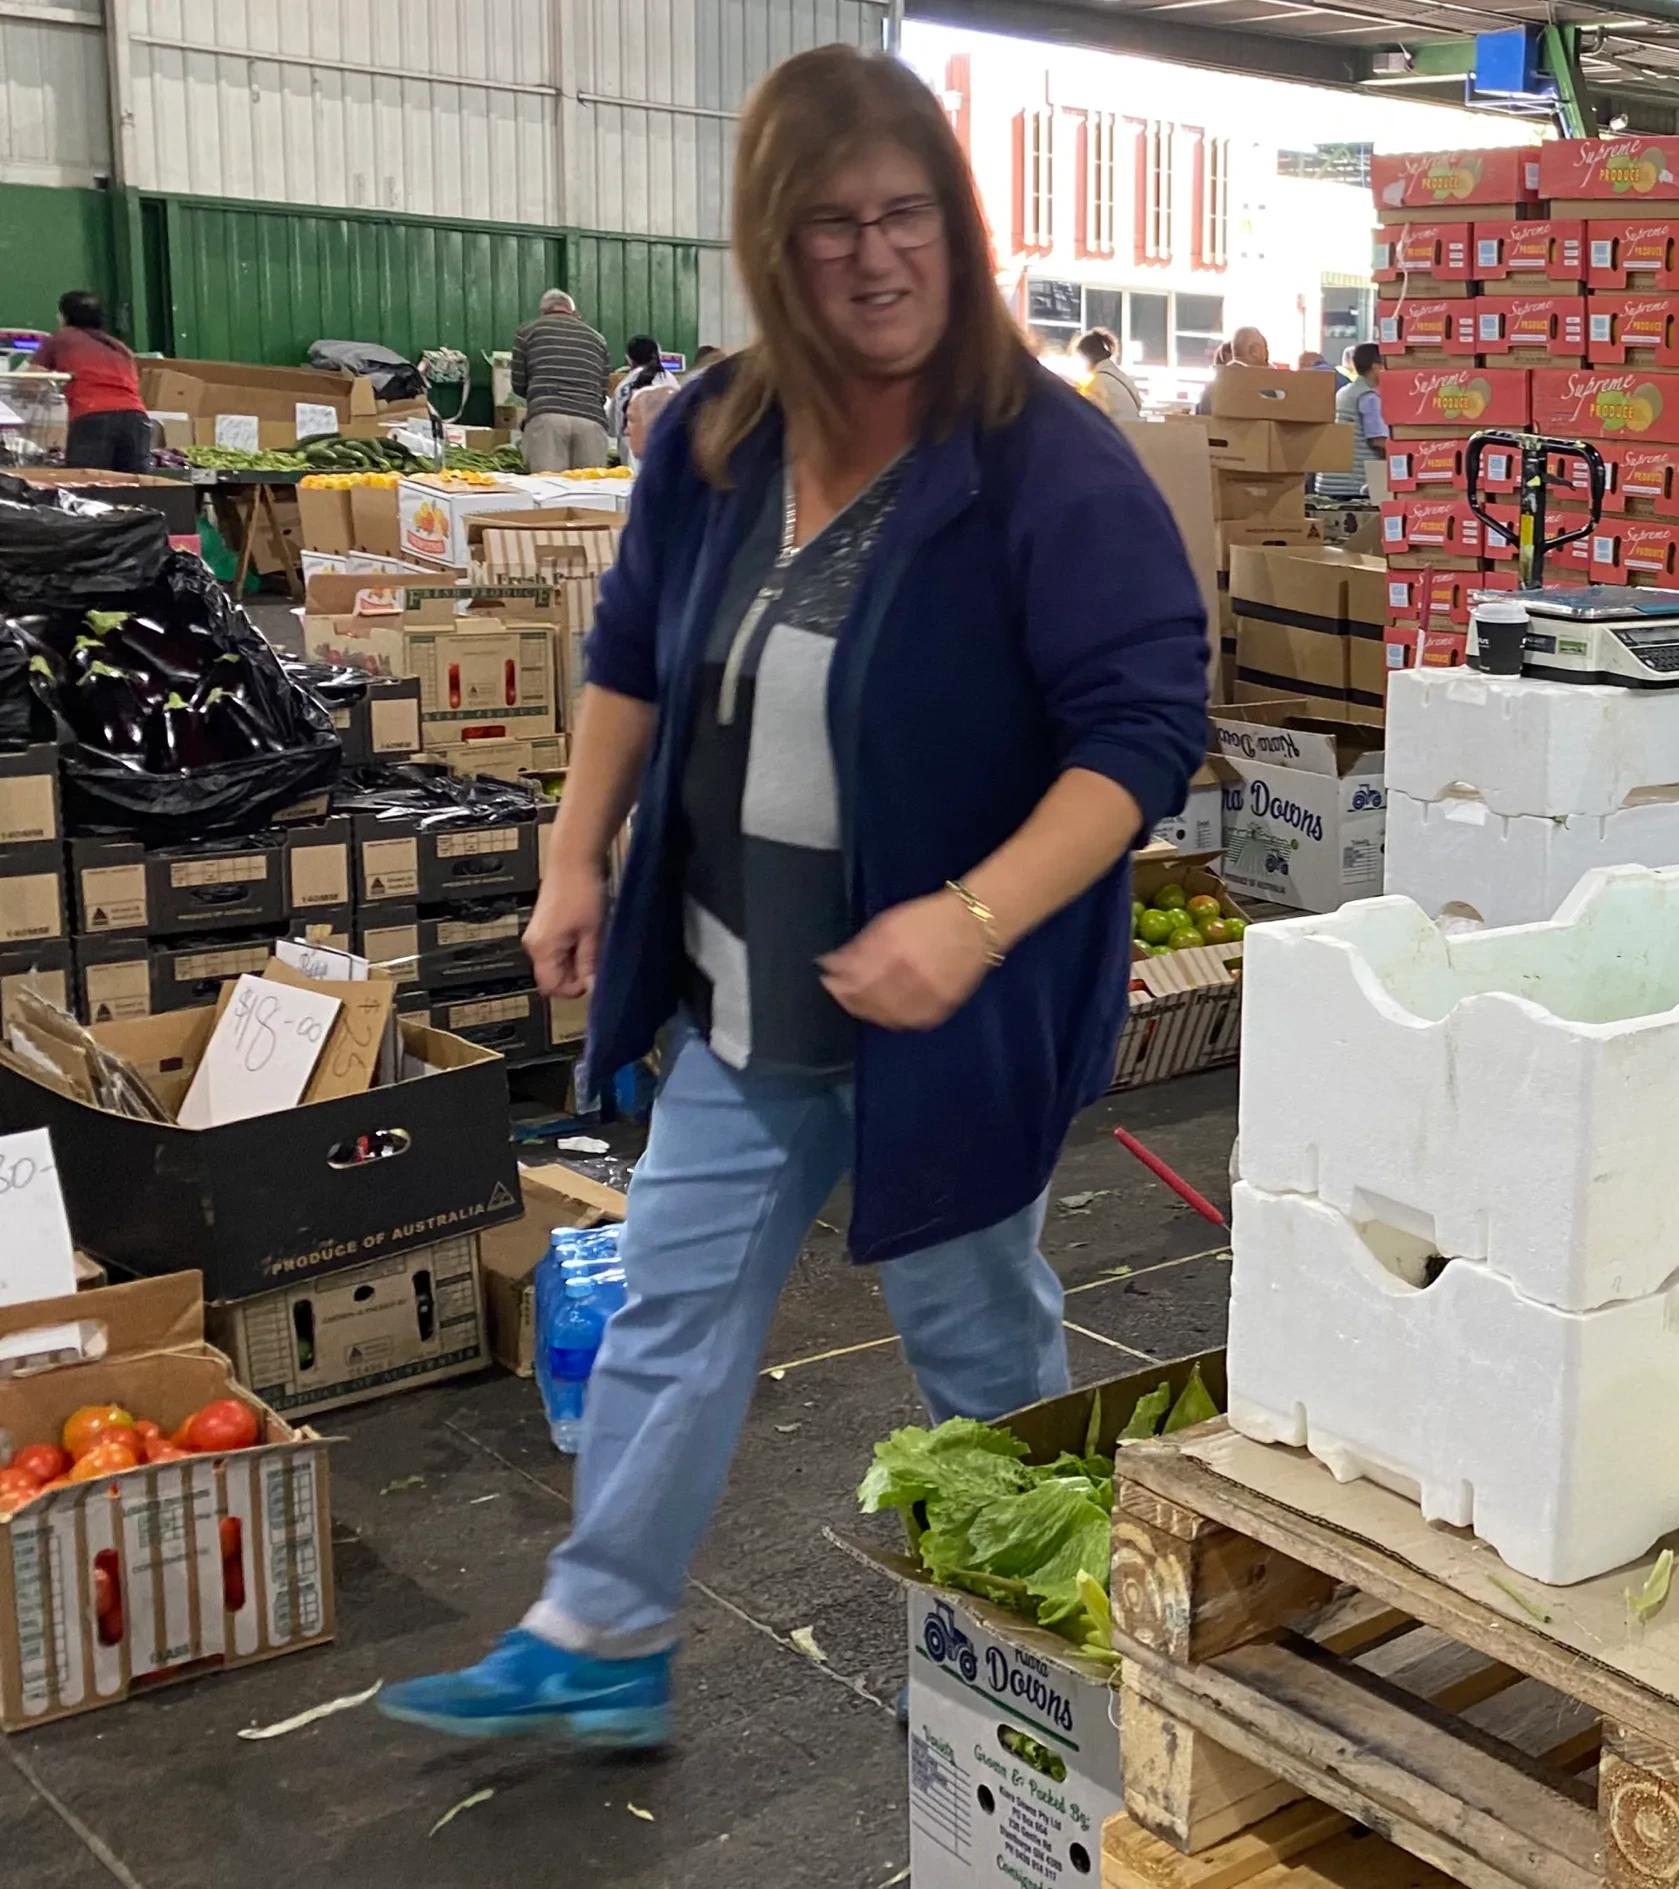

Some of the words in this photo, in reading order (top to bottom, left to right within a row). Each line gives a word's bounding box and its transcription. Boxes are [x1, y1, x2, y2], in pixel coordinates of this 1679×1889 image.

[1573, 140, 1642, 188] Supreme
[1600, 168, 1640, 182] PRODUCE
[1507, 224, 1551, 255] Supreme
[1621, 224, 1669, 257] Supreme
[1406, 302, 1447, 331] Supreme
[1508, 300, 1552, 330] Supreme
[1619, 300, 1669, 331] Supreme
[1410, 370, 1469, 415] Supreme
[1432, 394, 1468, 409] PRODUCE
[1561, 373, 1635, 421] Supreme
[1589, 404, 1633, 419] PRODUCE
[1621, 452, 1670, 480] Supreme
[1622, 527, 1671, 554] Supreme
[1216, 728, 1256, 758] Dow
[1258, 734, 1301, 758] Kiara
[1250, 780, 1324, 842] Downs
[271, 1241, 358, 1276] PRODUCE
[363, 1233, 385, 1249] OF
[391, 1203, 486, 1240] AUSTRALIA
[986, 1645, 1073, 1732] Downs
